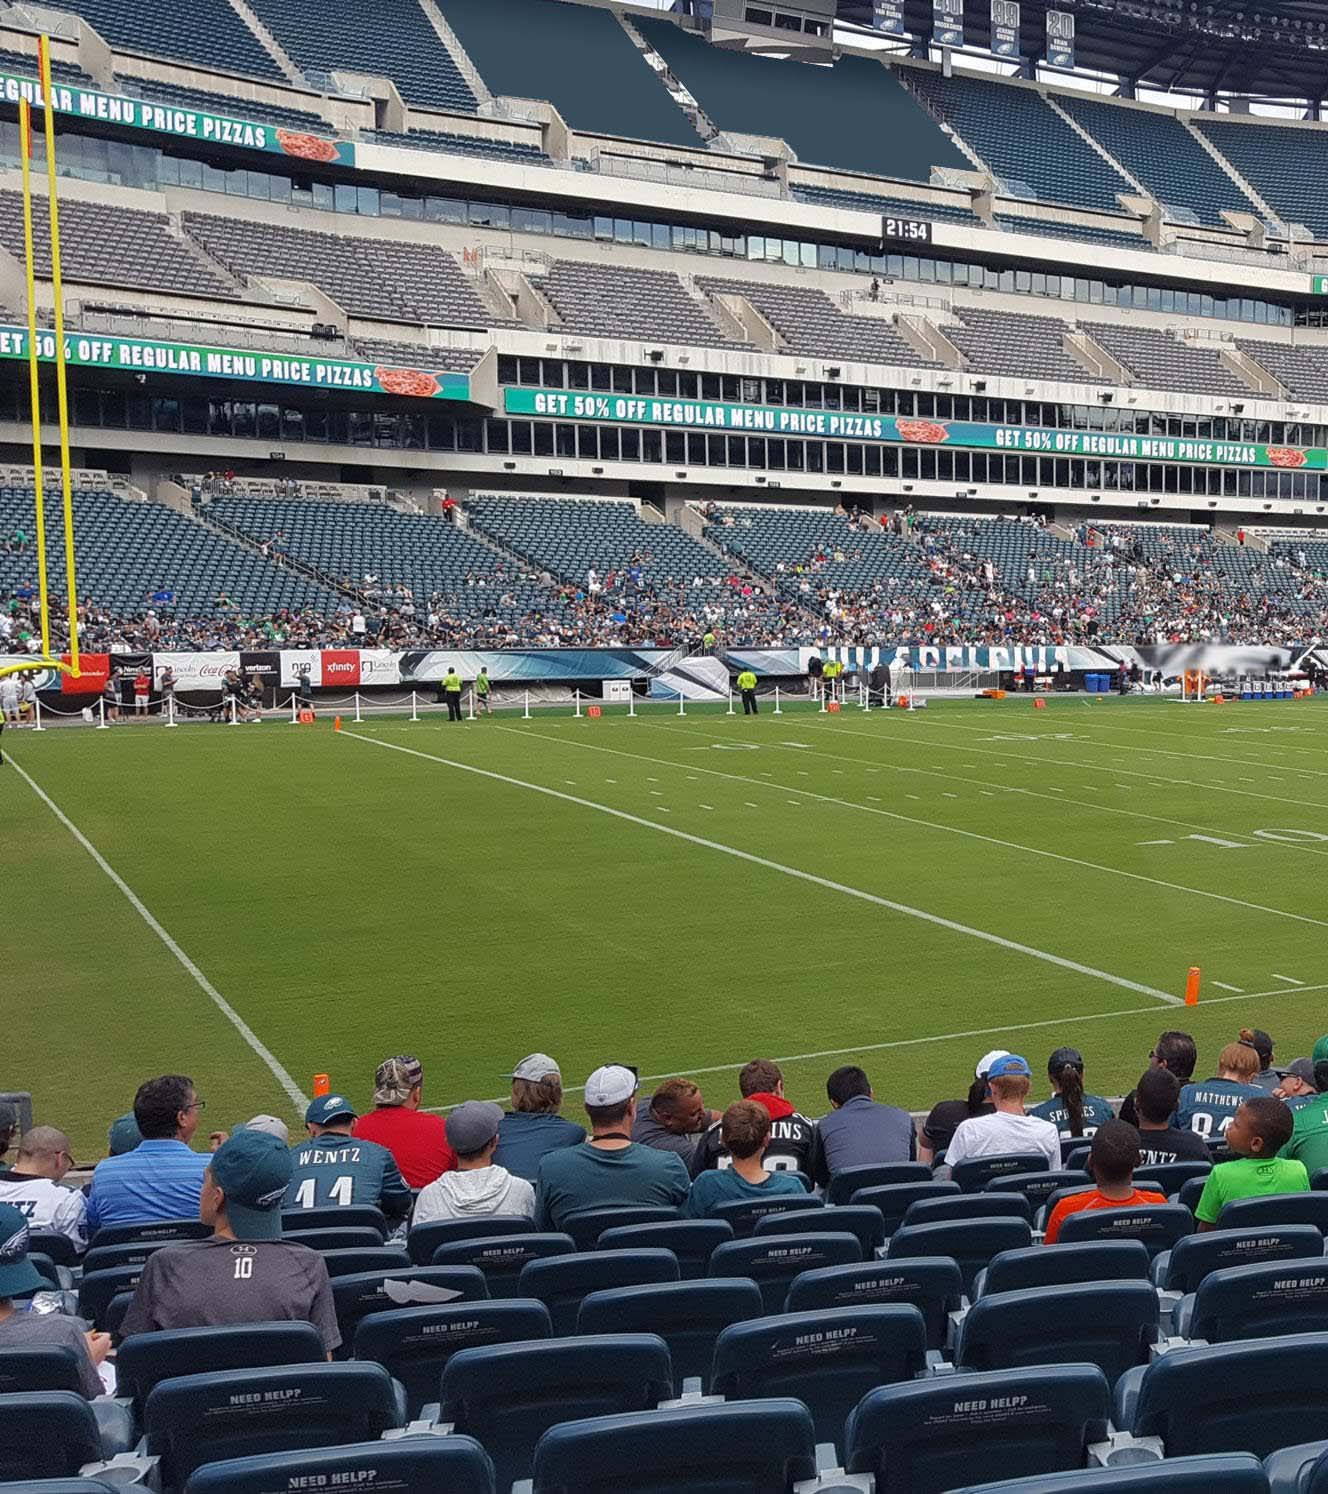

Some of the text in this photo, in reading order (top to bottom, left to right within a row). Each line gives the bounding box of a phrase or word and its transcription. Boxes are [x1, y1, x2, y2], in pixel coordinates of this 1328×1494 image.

[1047, 10, 1073, 39] 20
[80, 92, 135, 123] MENU
[141, 105, 197, 135] PRICE
[203, 117, 266, 148] PIZZAS
[886, 218, 928, 240] 21:54
[78, 339, 113, 363] OFF
[119, 343, 201, 371] REGULAR
[207, 352, 256, 377] MENU
[261, 358, 311, 382] PRICE
[316, 364, 372, 388] PIZZAS
[535, 392, 882, 437] GET 50% OFF REGULAR MENU PRICE PIZZAS
[995, 428, 1256, 462] GET 50% OFF REGULAR MENU PRICE PIZZAS
[327, 662, 356, 673] xfinity
[1194, 1091, 1244, 1107] MATTHEWS
[299, 1147, 361, 1165] WENTZ
[1139, 1149, 1177, 1164] ENTZ
[295, 1176, 353, 1208] 11
[1235, 1238, 1280, 1249] NEED HELP?
[233, 1257, 253, 1279] 10
[854, 1278, 905, 1290] NEED HELP?
[1274, 1278, 1326, 1290] NEED HELP?
[422, 1321, 480, 1335] NEED HELP?
[795, 1328, 857, 1346] NEED HELP?
[229, 1388, 302, 1405] NEED HELP?
[953, 1395, 1029, 1413] NEED HELP?
[287, 1474, 327, 1490] NEED
[330, 1469, 377, 1484] HELP?
